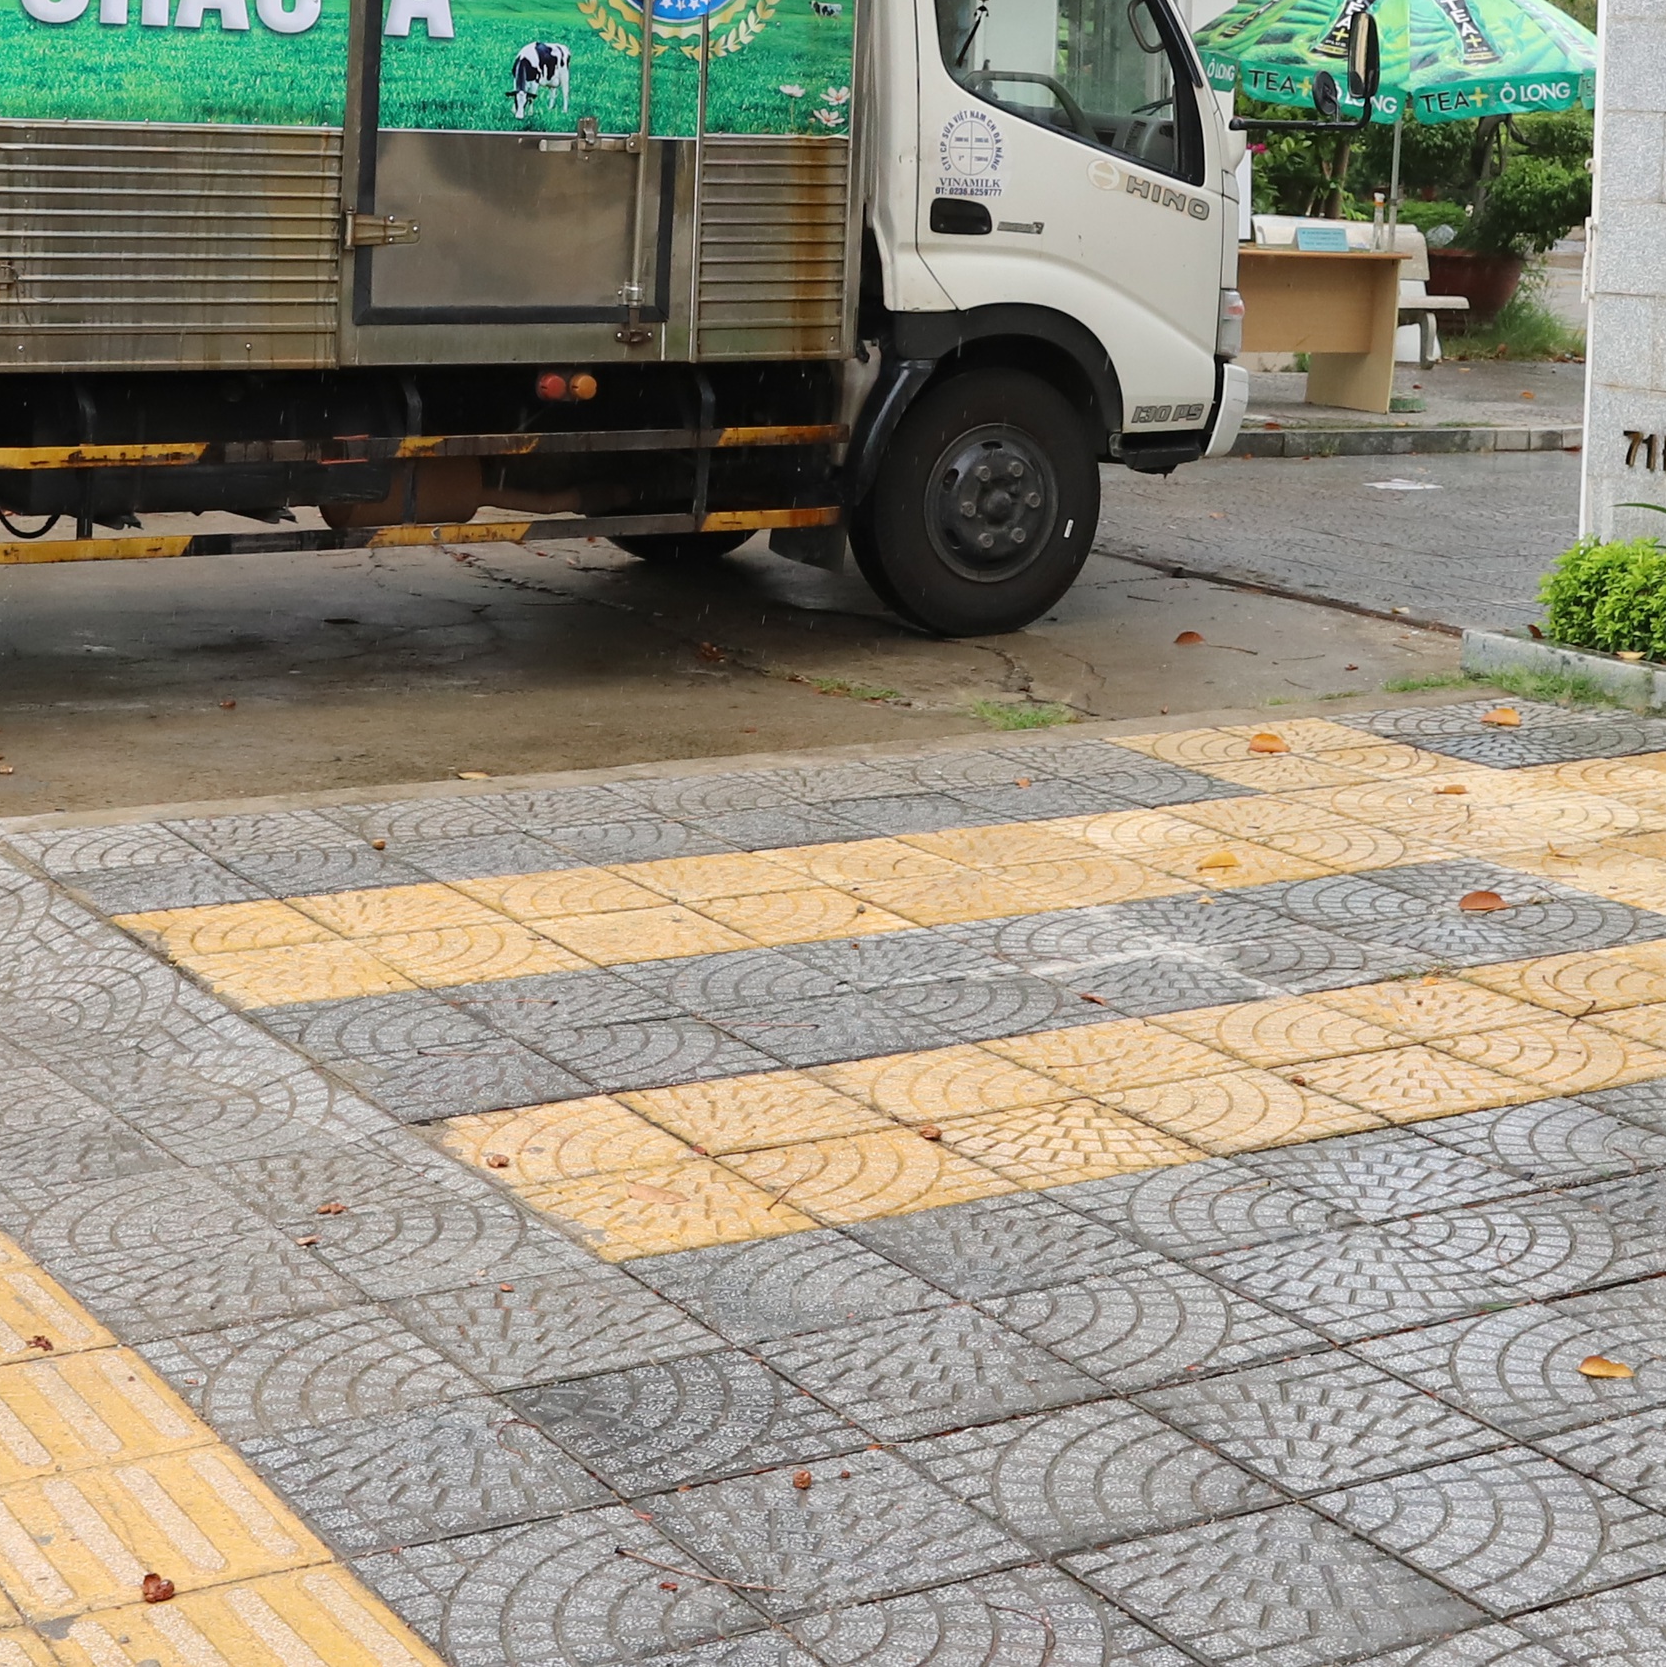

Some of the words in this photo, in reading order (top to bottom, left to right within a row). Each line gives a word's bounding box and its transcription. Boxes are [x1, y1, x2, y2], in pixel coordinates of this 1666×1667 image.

[1500, 82, 1516, 104] Ô
[1520, 81, 1571, 103] LONG
[970, 110, 987, 122] NAM
[939, 177, 1002, 188] VINAMILK
[1126, 175, 1211, 221] HINO
[1131, 405, 1172, 424] 130
[1171, 403, 1204, 422] PS
